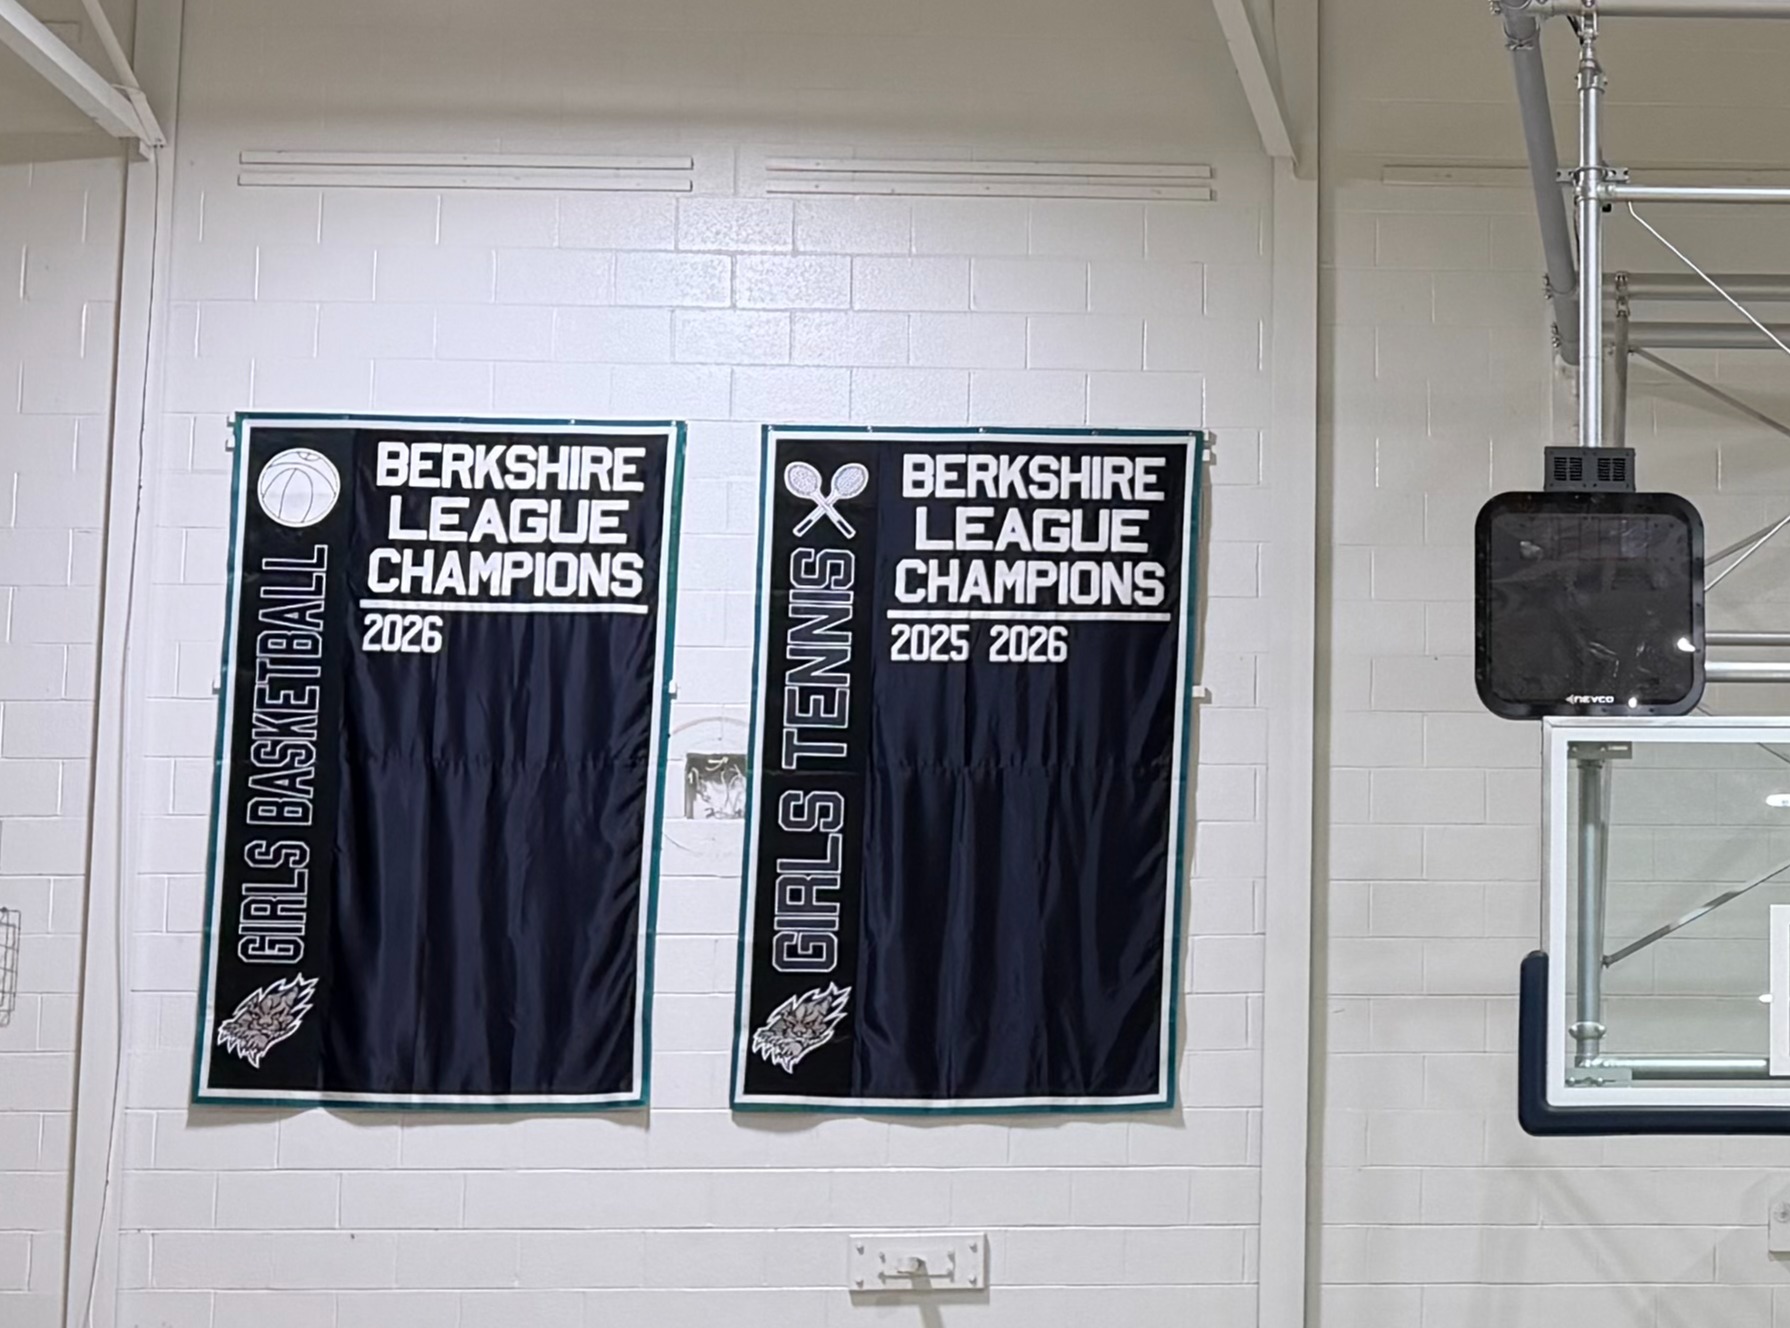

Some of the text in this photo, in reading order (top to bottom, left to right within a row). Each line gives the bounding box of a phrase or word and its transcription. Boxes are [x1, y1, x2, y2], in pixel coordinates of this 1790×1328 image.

[376, 441, 647, 493] BERKSHIRE
[902, 453, 1166, 501] BERKSHIRE
[387, 494, 630, 545] LEAGUE
[915, 505, 1150, 553] LEAGUE
[367, 547, 645, 598] CHAMPIONS
[894, 558, 1165, 606] CHAMPIONS
[361, 613, 444, 654] 2026
[890, 623, 1069, 663] 2025 2026
[237, 543, 329, 964] GIRLS BASKETBALL
[771, 546, 856, 973] GIRLS TENNIS
